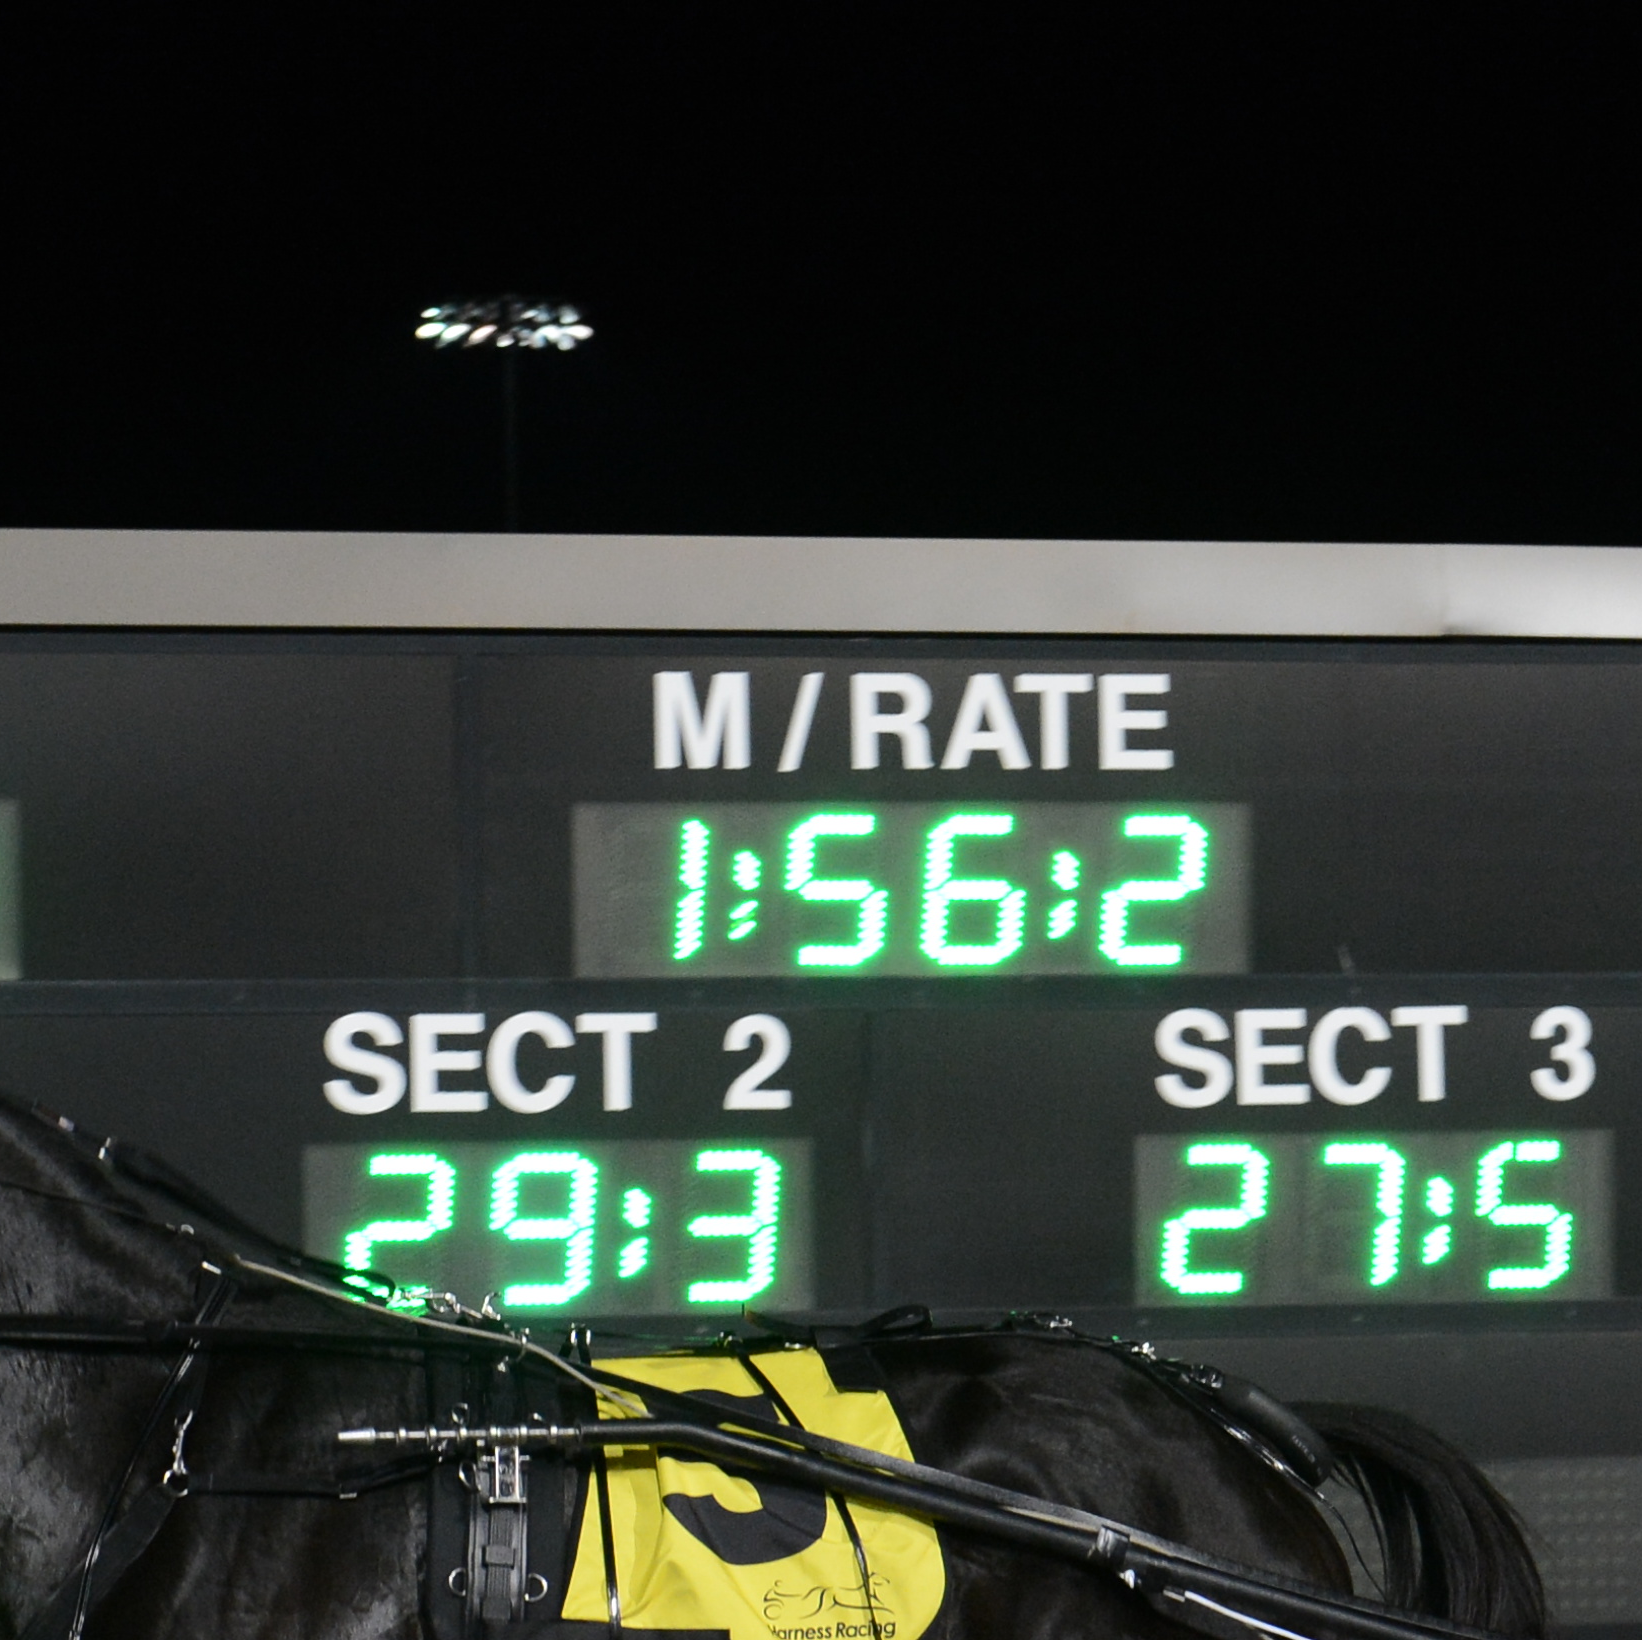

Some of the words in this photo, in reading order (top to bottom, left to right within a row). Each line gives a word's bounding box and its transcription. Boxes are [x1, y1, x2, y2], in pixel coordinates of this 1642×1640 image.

[673, 812, 1209, 967] 1:56:2
[324, 1011, 656, 1114] SECT
[724, 1014, 790, 1109] 2
[1155, 1006, 1467, 1108] SECT
[1531, 1006, 1594, 1100] 3
[1160, 1141, 1572, 1294] 27:5
